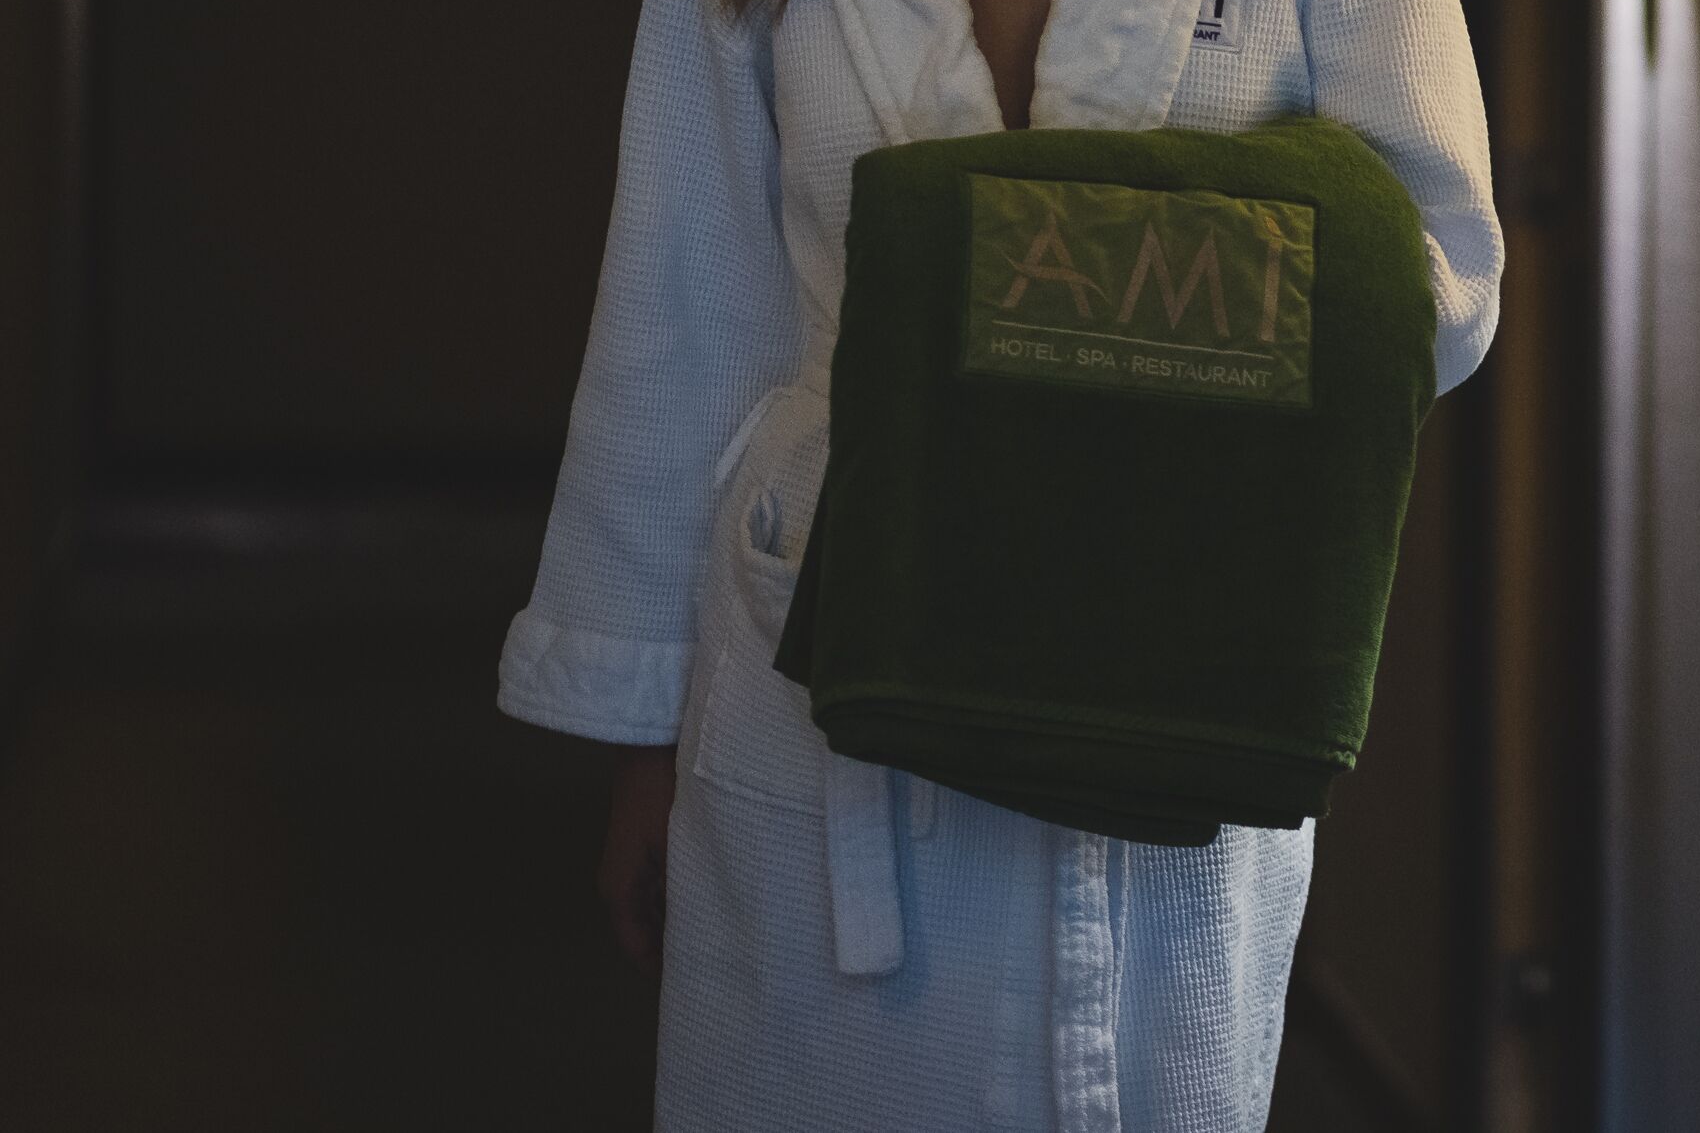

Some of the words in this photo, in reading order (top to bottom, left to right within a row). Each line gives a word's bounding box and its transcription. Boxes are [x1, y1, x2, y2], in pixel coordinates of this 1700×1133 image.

[990, 338, 1061, 361] HOTEL
[1076, 347, 1116, 370] SPA
[1131, 355, 1272, 387] RESTAURANT
